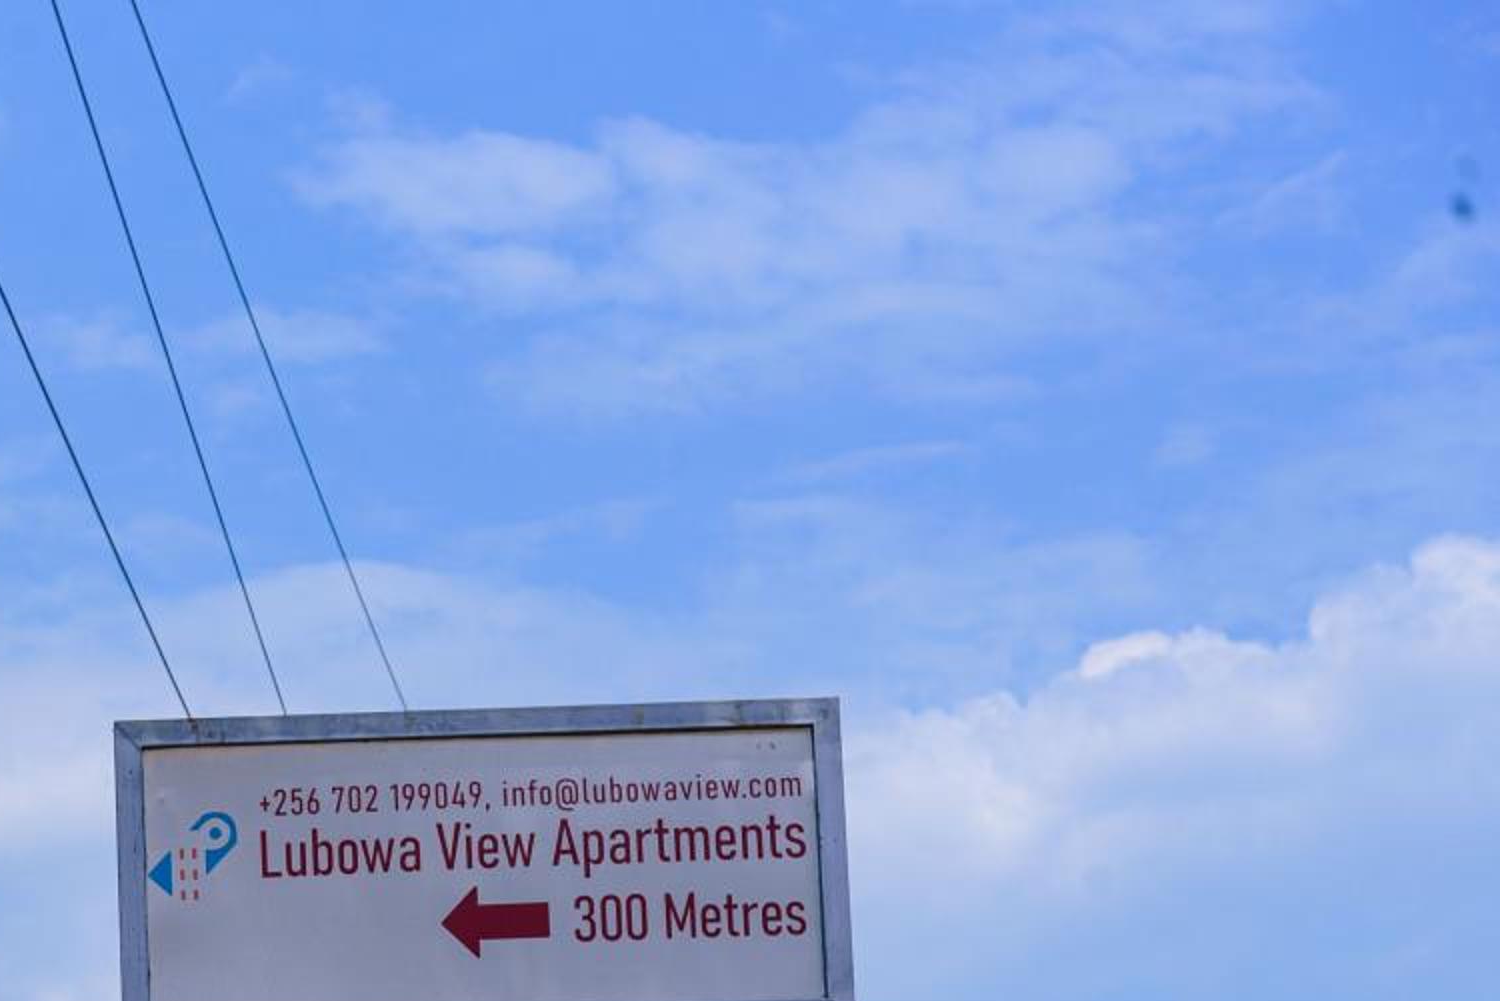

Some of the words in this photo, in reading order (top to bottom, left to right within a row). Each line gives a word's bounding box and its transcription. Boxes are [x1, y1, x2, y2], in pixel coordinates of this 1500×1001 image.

[259, 788, 321, 817] +256
[331, 784, 378, 813] 702
[390, 781, 491, 811] 199049,
[502, 774, 801, 812] info@lubowaview.com
[260, 827, 421, 879] Lubowa
[436, 821, 535, 870] View
[552, 814, 807, 878] Apartments
[574, 893, 648, 942] 300
[664, 890, 807, 939] Metres
